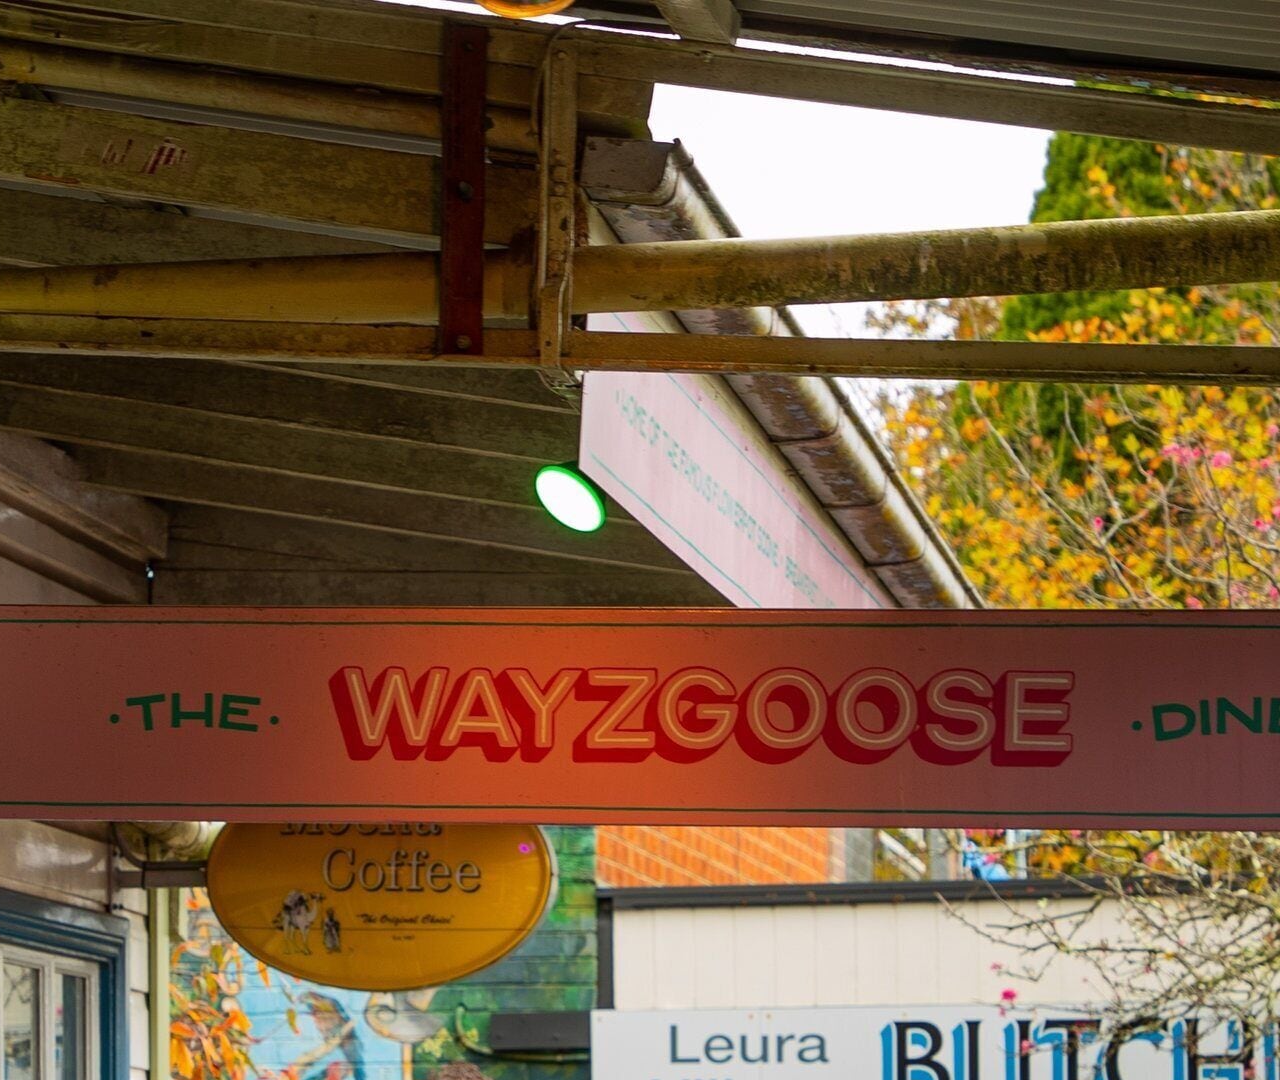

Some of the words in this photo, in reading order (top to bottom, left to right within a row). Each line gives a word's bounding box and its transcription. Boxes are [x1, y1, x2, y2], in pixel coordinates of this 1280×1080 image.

[328, 665, 1076, 768] WAYZGOOSE
[323, 848, 481, 893] Coffee
[670, 1025, 829, 1065] Leura
